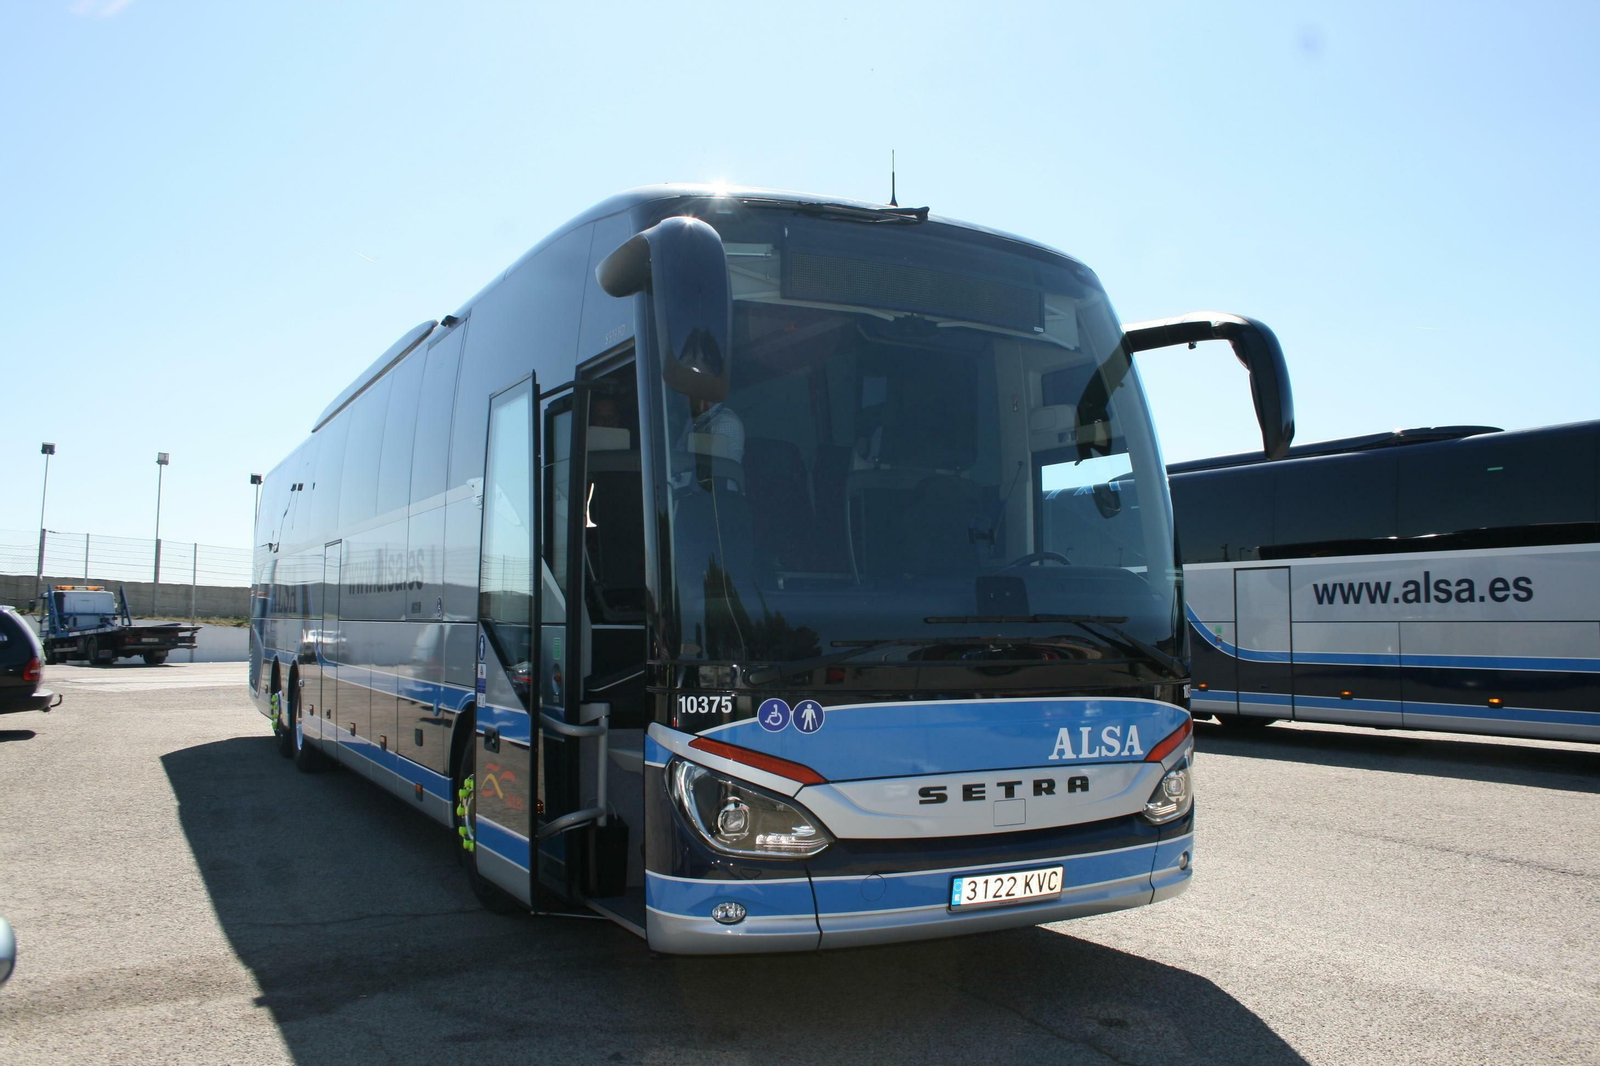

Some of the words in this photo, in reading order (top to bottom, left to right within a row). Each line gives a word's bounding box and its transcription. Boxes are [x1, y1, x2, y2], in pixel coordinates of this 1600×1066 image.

[1313, 571, 1534, 604] www.alsa.es
[679, 696, 732, 714] 10375
[1048, 725, 1144, 760] ALSA
[918, 775, 1090, 805] SETRA
[966, 876, 1017, 901] 3122
[1024, 871, 1058, 895] KVC
